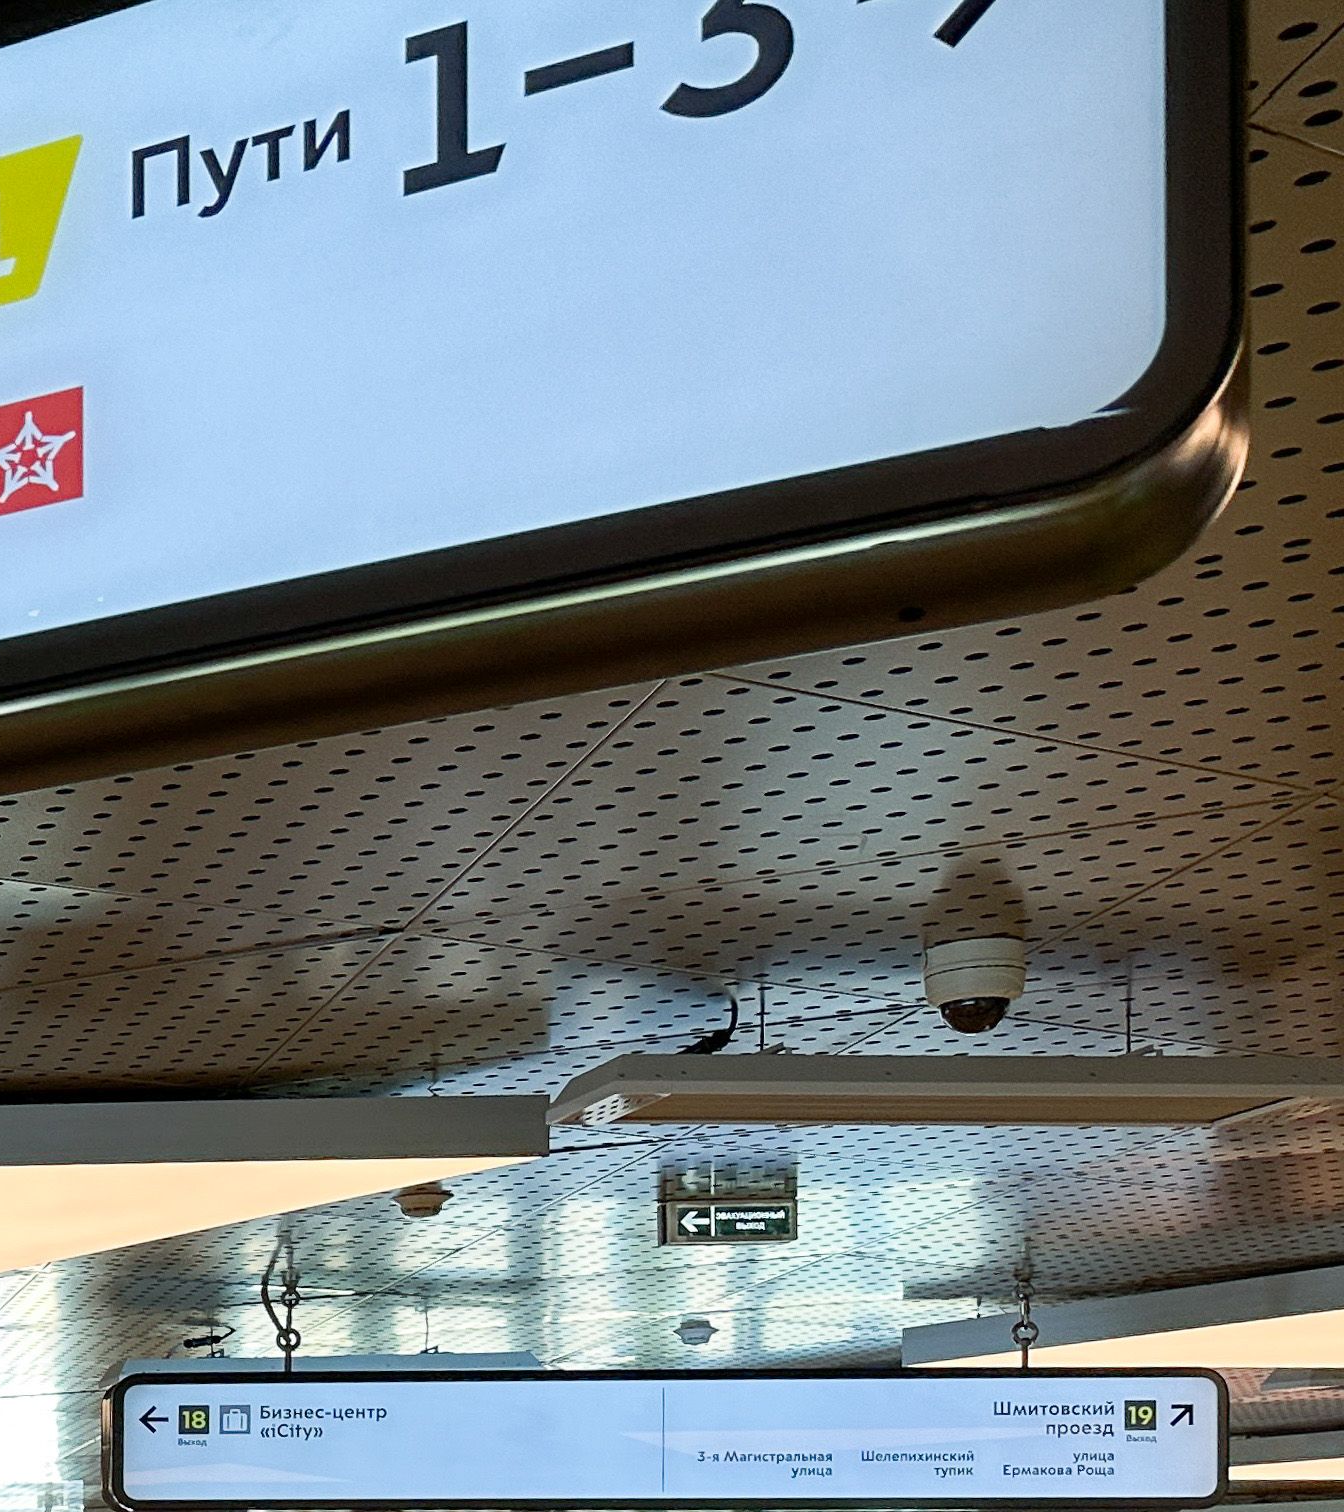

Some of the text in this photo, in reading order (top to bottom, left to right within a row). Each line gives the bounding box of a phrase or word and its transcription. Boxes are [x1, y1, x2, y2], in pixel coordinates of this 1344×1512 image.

[132, 109, 351, 219] Пути
[261, 1405, 388, 1421] Бизнес-центр
[993, 1401, 1115, 1416] Шмитовский
[1128, 1405, 1154, 1425] 19
[182, 1410, 207, 1430] 18
[261, 1424, 324, 1440] «iCity»
[1046, 1424, 1115, 1438] проезд
[723, 1451, 833, 1464] Магистральная
[861, 1451, 975, 1462] Шелепихинский
[1073, 1452, 1115, 1463] улица
[791, 1466, 833, 1478] улица
[934, 1466, 974, 1478] тупик
[1003, 1465, 1115, 1477] Ермакова Роща
